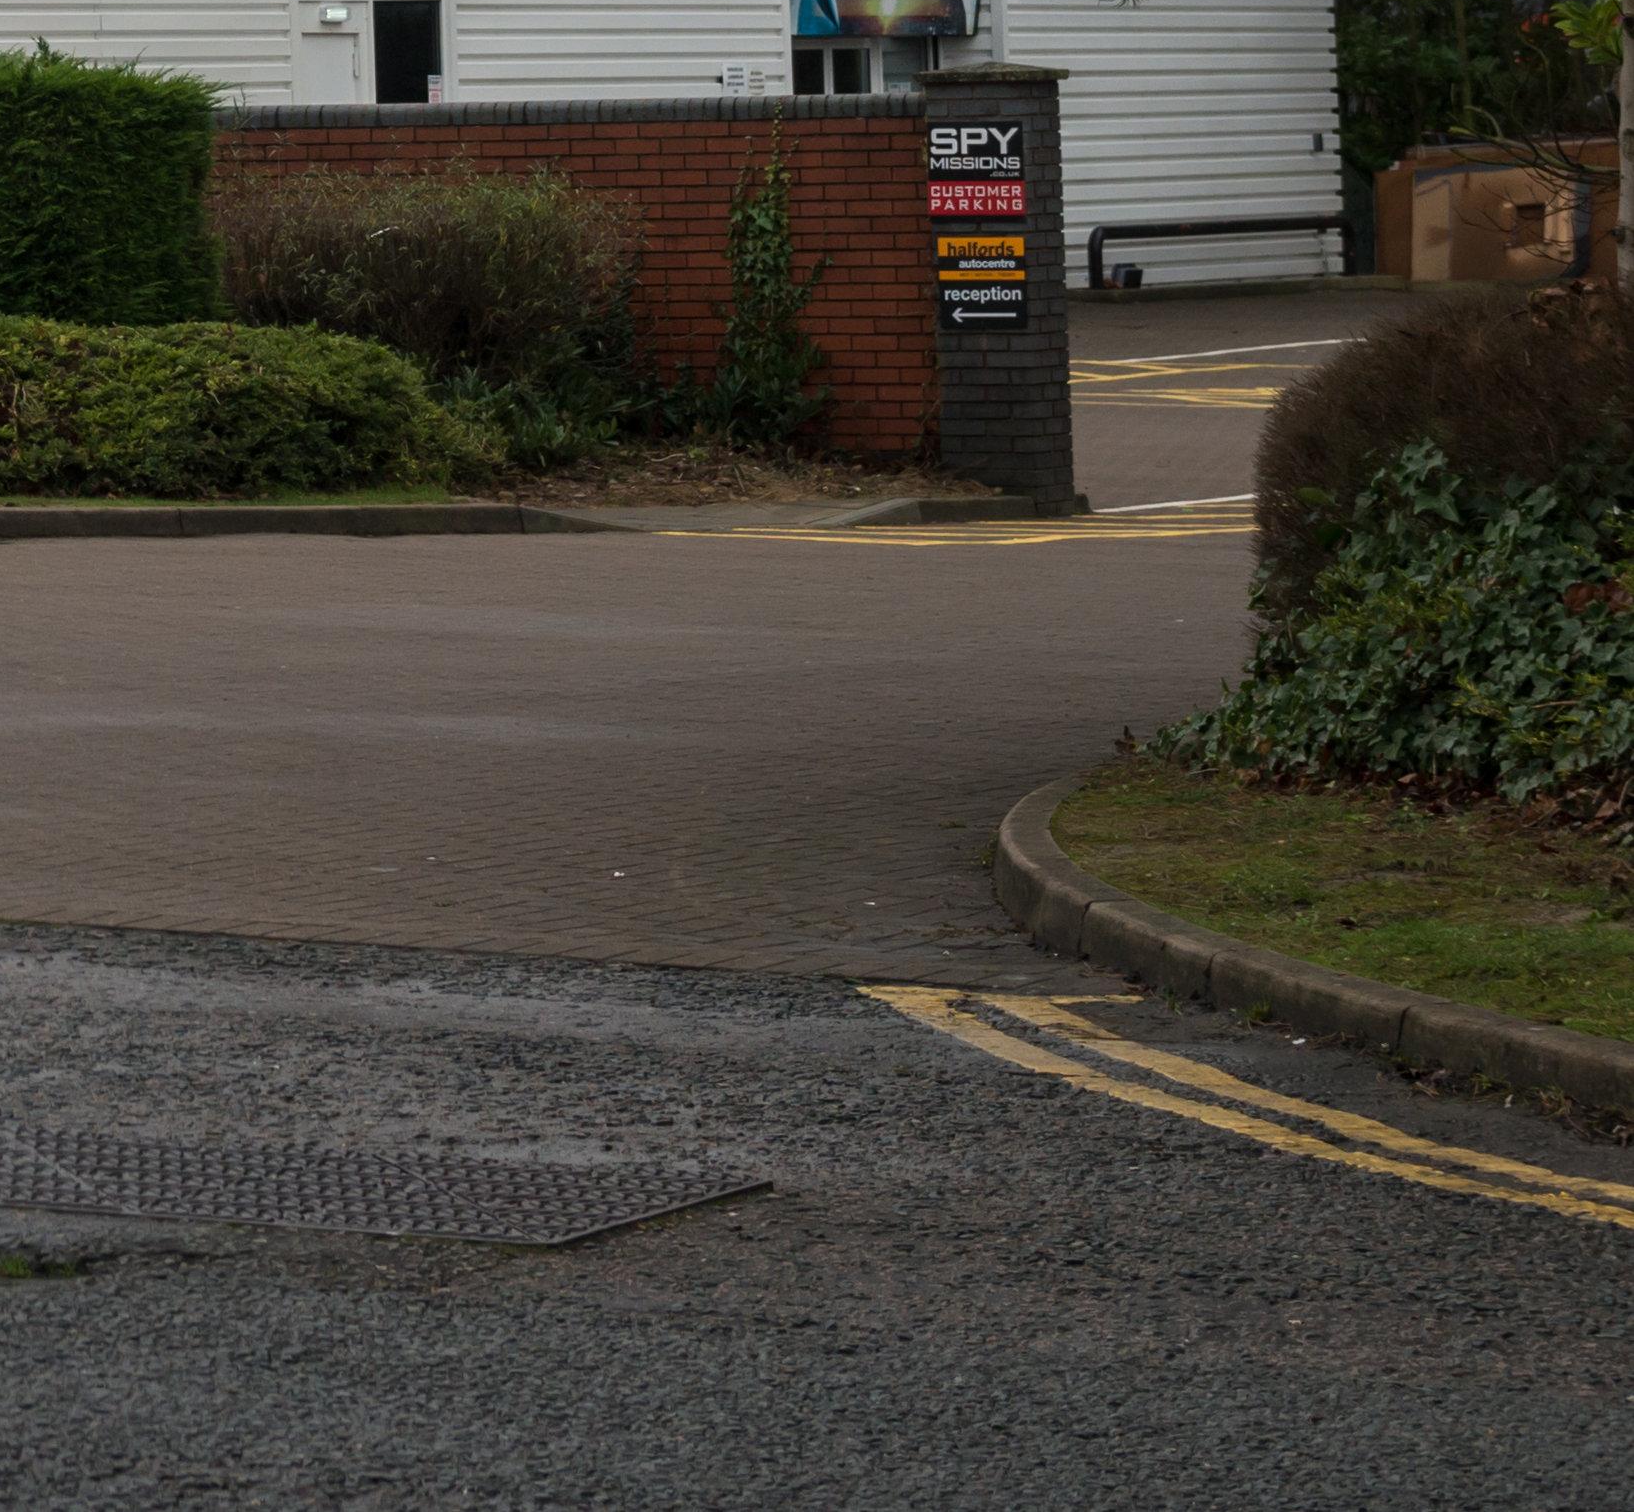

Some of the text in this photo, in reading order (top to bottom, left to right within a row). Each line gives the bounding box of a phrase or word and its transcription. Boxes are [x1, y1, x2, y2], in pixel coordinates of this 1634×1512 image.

[930, 127, 1020, 155] SPY
[929, 156, 1021, 171] MISSIONS
[930, 184, 1022, 198] CUSTOMER
[930, 198, 1024, 212] PARKING
[947, 241, 1016, 259] halfords
[958, 258, 1017, 270] autocentre
[943, 285, 1023, 305] reception
